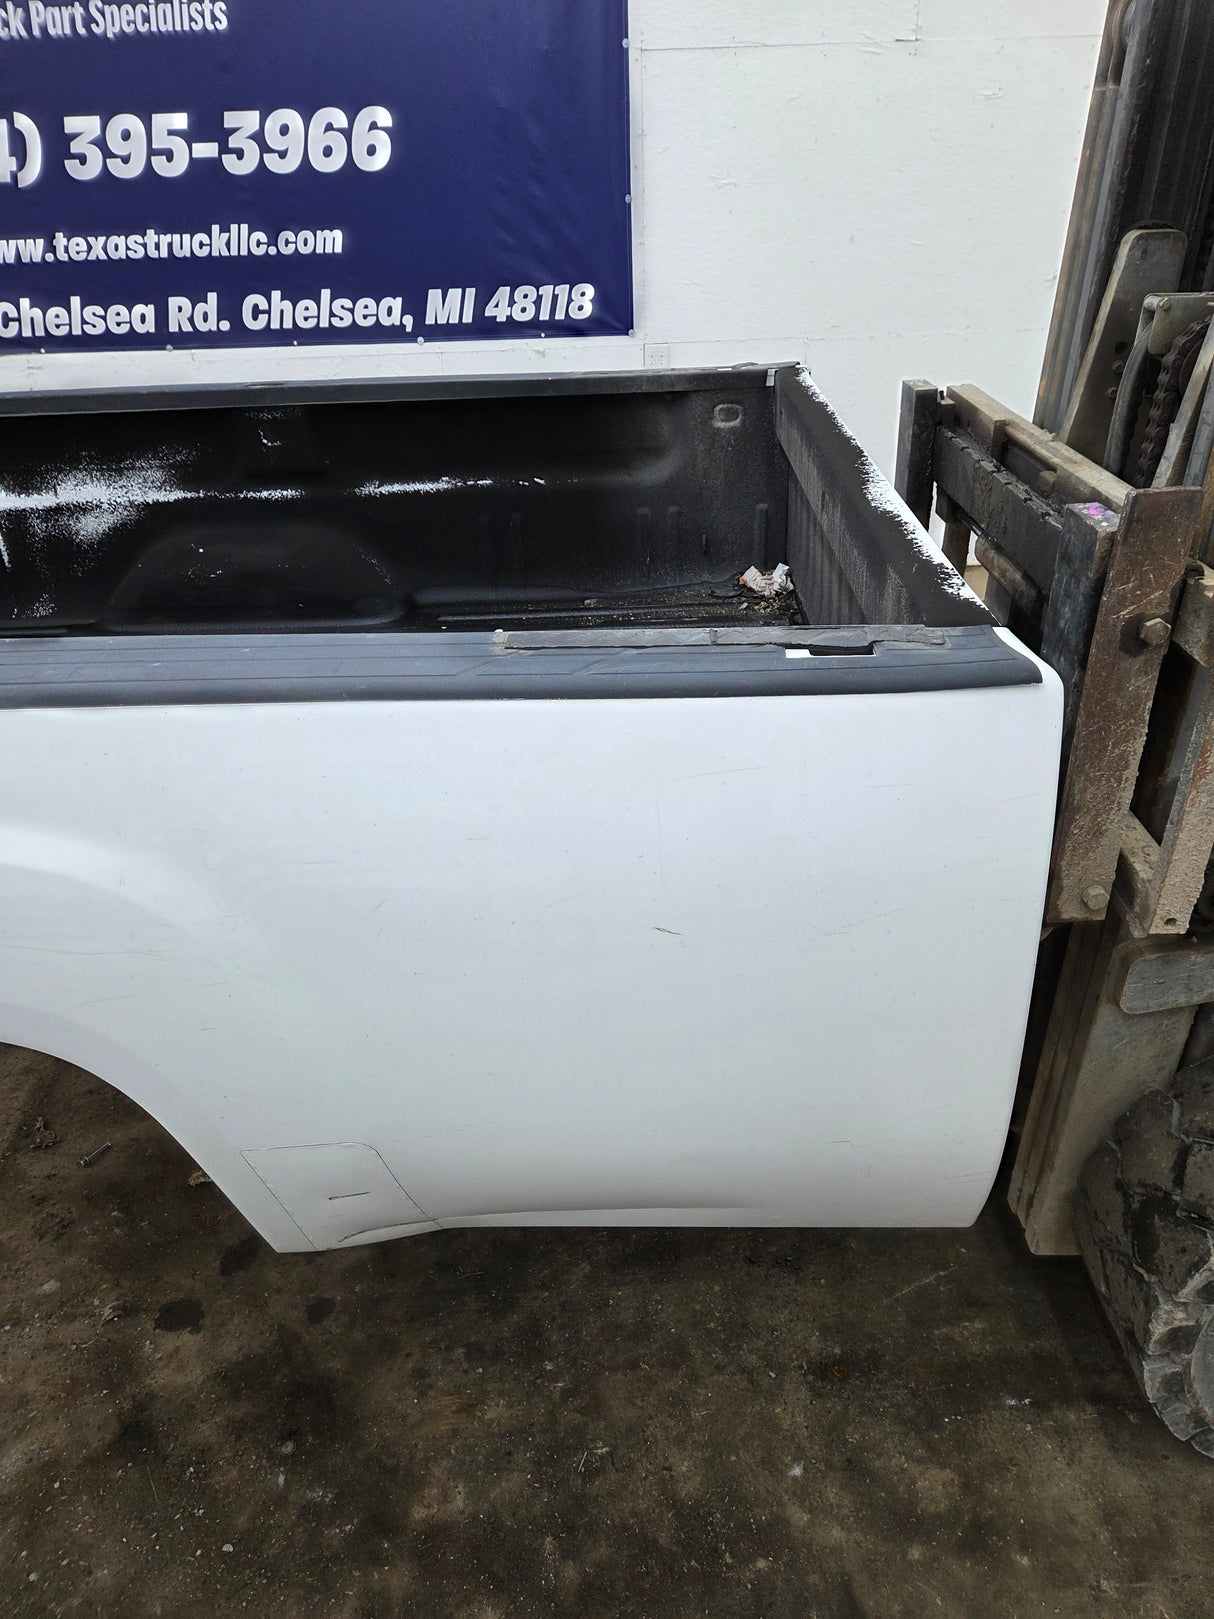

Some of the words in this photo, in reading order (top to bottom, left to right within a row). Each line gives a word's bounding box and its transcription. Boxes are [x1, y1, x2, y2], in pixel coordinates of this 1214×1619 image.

[29, 0, 87, 37] Part
[89, 0, 229, 38] Specialists
[63, 105, 393, 181] 395-3966
[0, 296, 155, 338] Chelsea
[167, 291, 231, 333] Rd.
[241, 288, 414, 333] Chelsea,
[425, 287, 476, 325] MI
[484, 282, 595, 323] 48118
